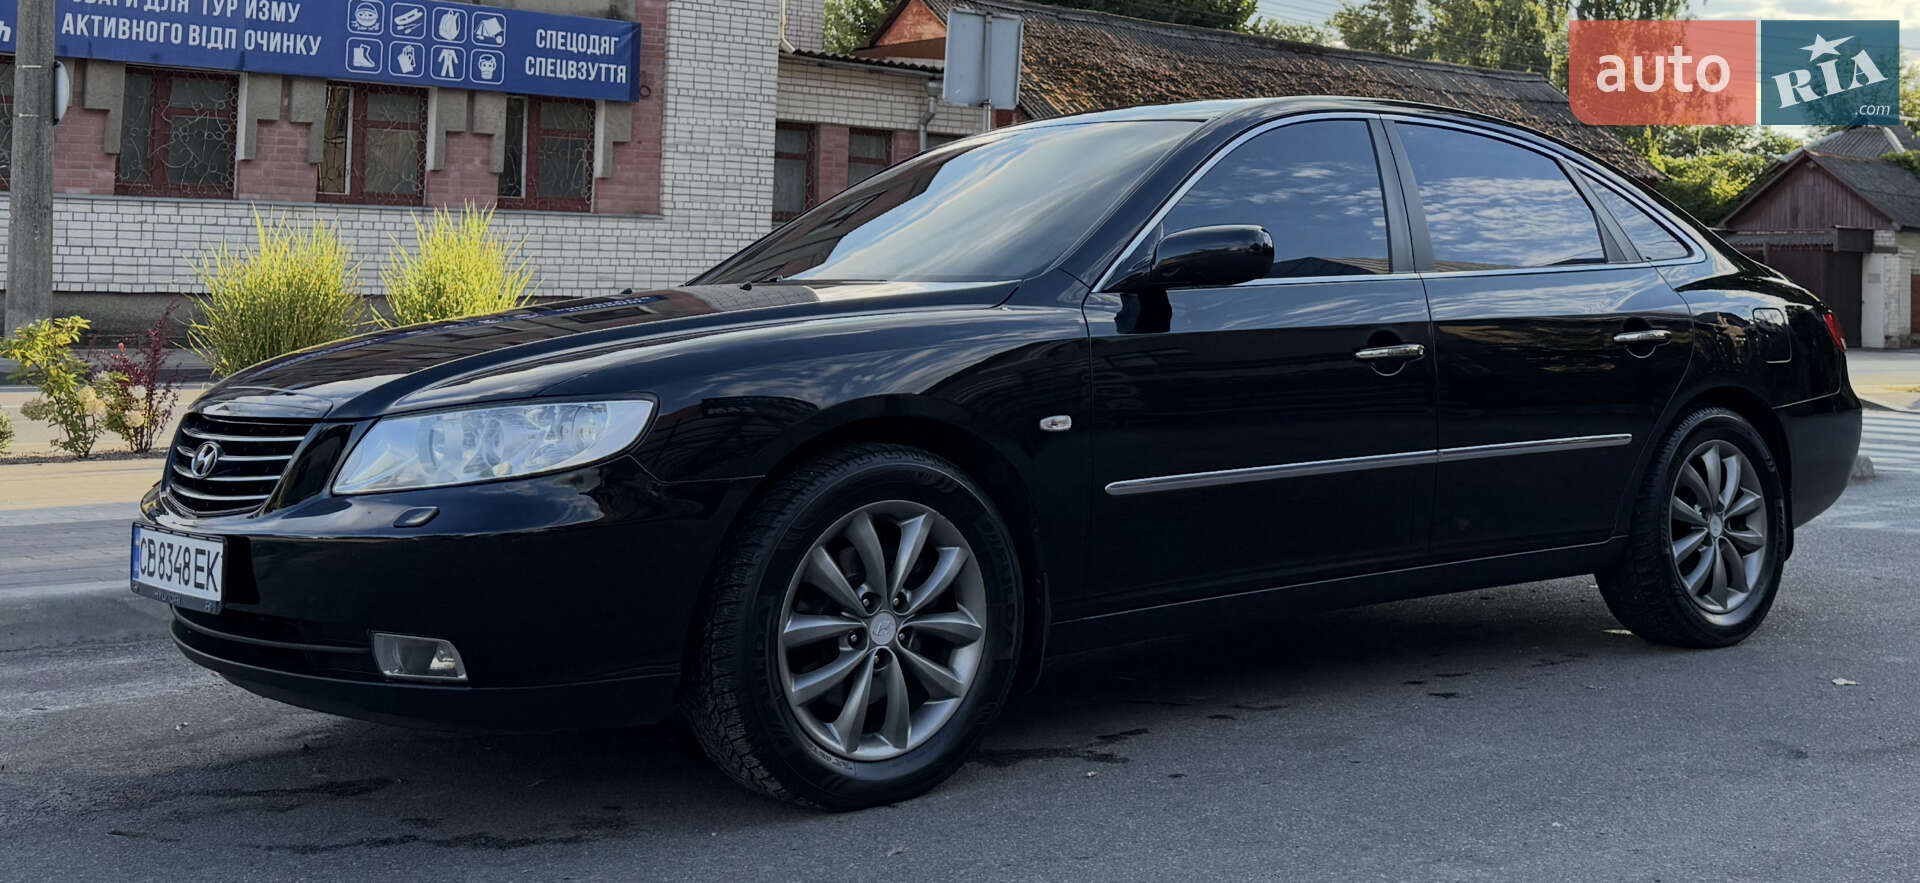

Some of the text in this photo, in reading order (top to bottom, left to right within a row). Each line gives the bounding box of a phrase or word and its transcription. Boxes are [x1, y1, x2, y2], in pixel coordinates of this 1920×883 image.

[61, 13, 183, 44] АКТИВНОГО
[535, 29, 619, 56] СПЕЦОДЯГ
[525, 56, 627, 84] СПЕЦВЗУТТЯ
